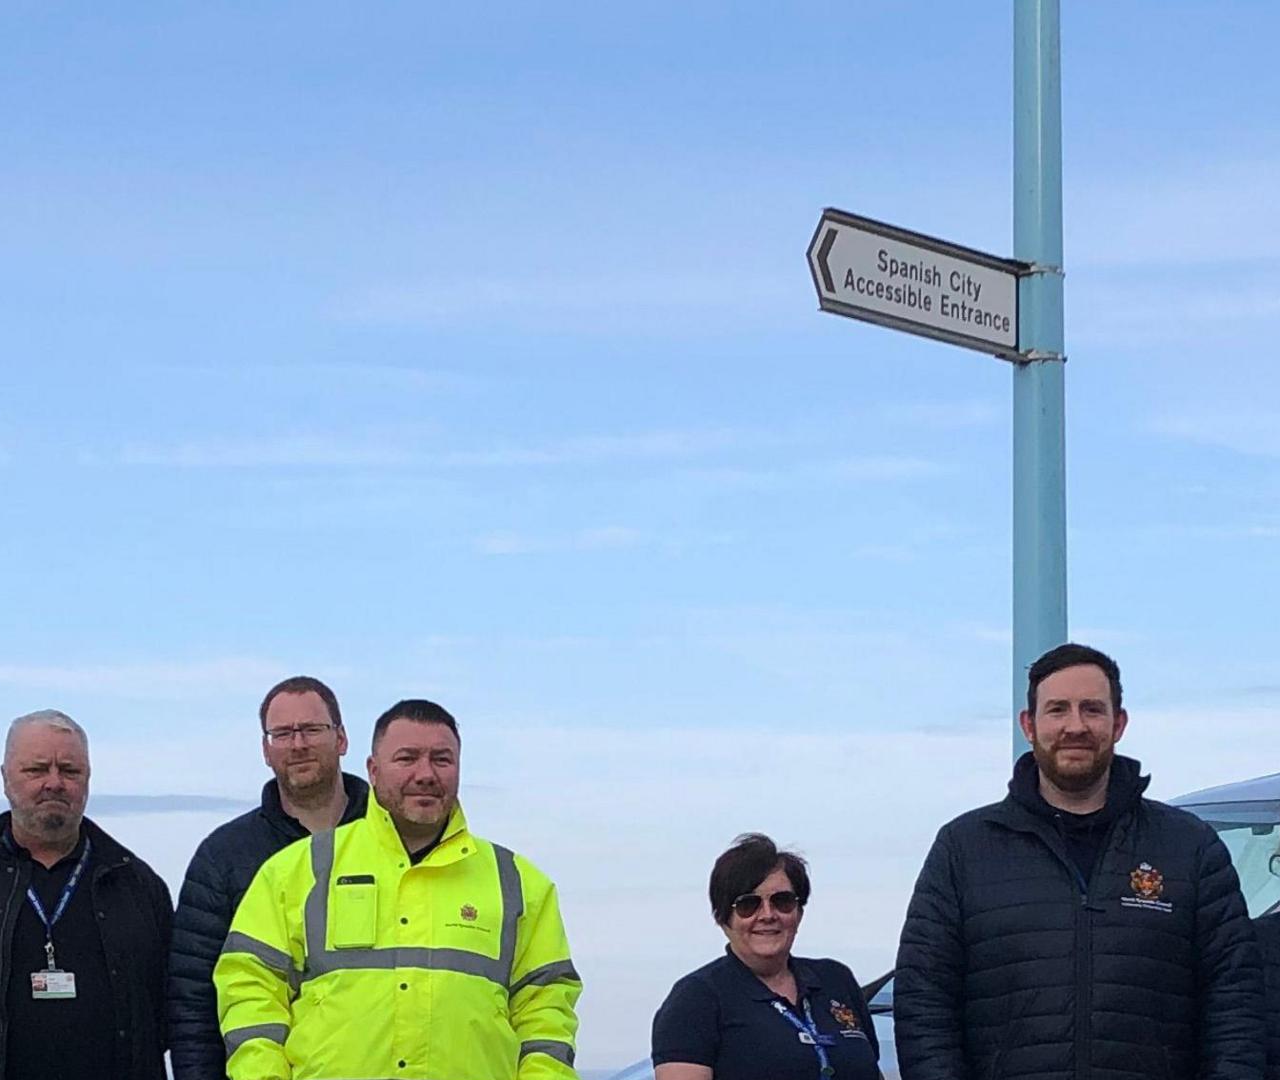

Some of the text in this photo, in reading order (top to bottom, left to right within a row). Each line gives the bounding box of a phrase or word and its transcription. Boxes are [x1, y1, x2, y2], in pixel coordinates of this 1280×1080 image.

[844, 268, 1010, 333] Accessible Entrance
[877, 249, 982, 302] Spanish City
